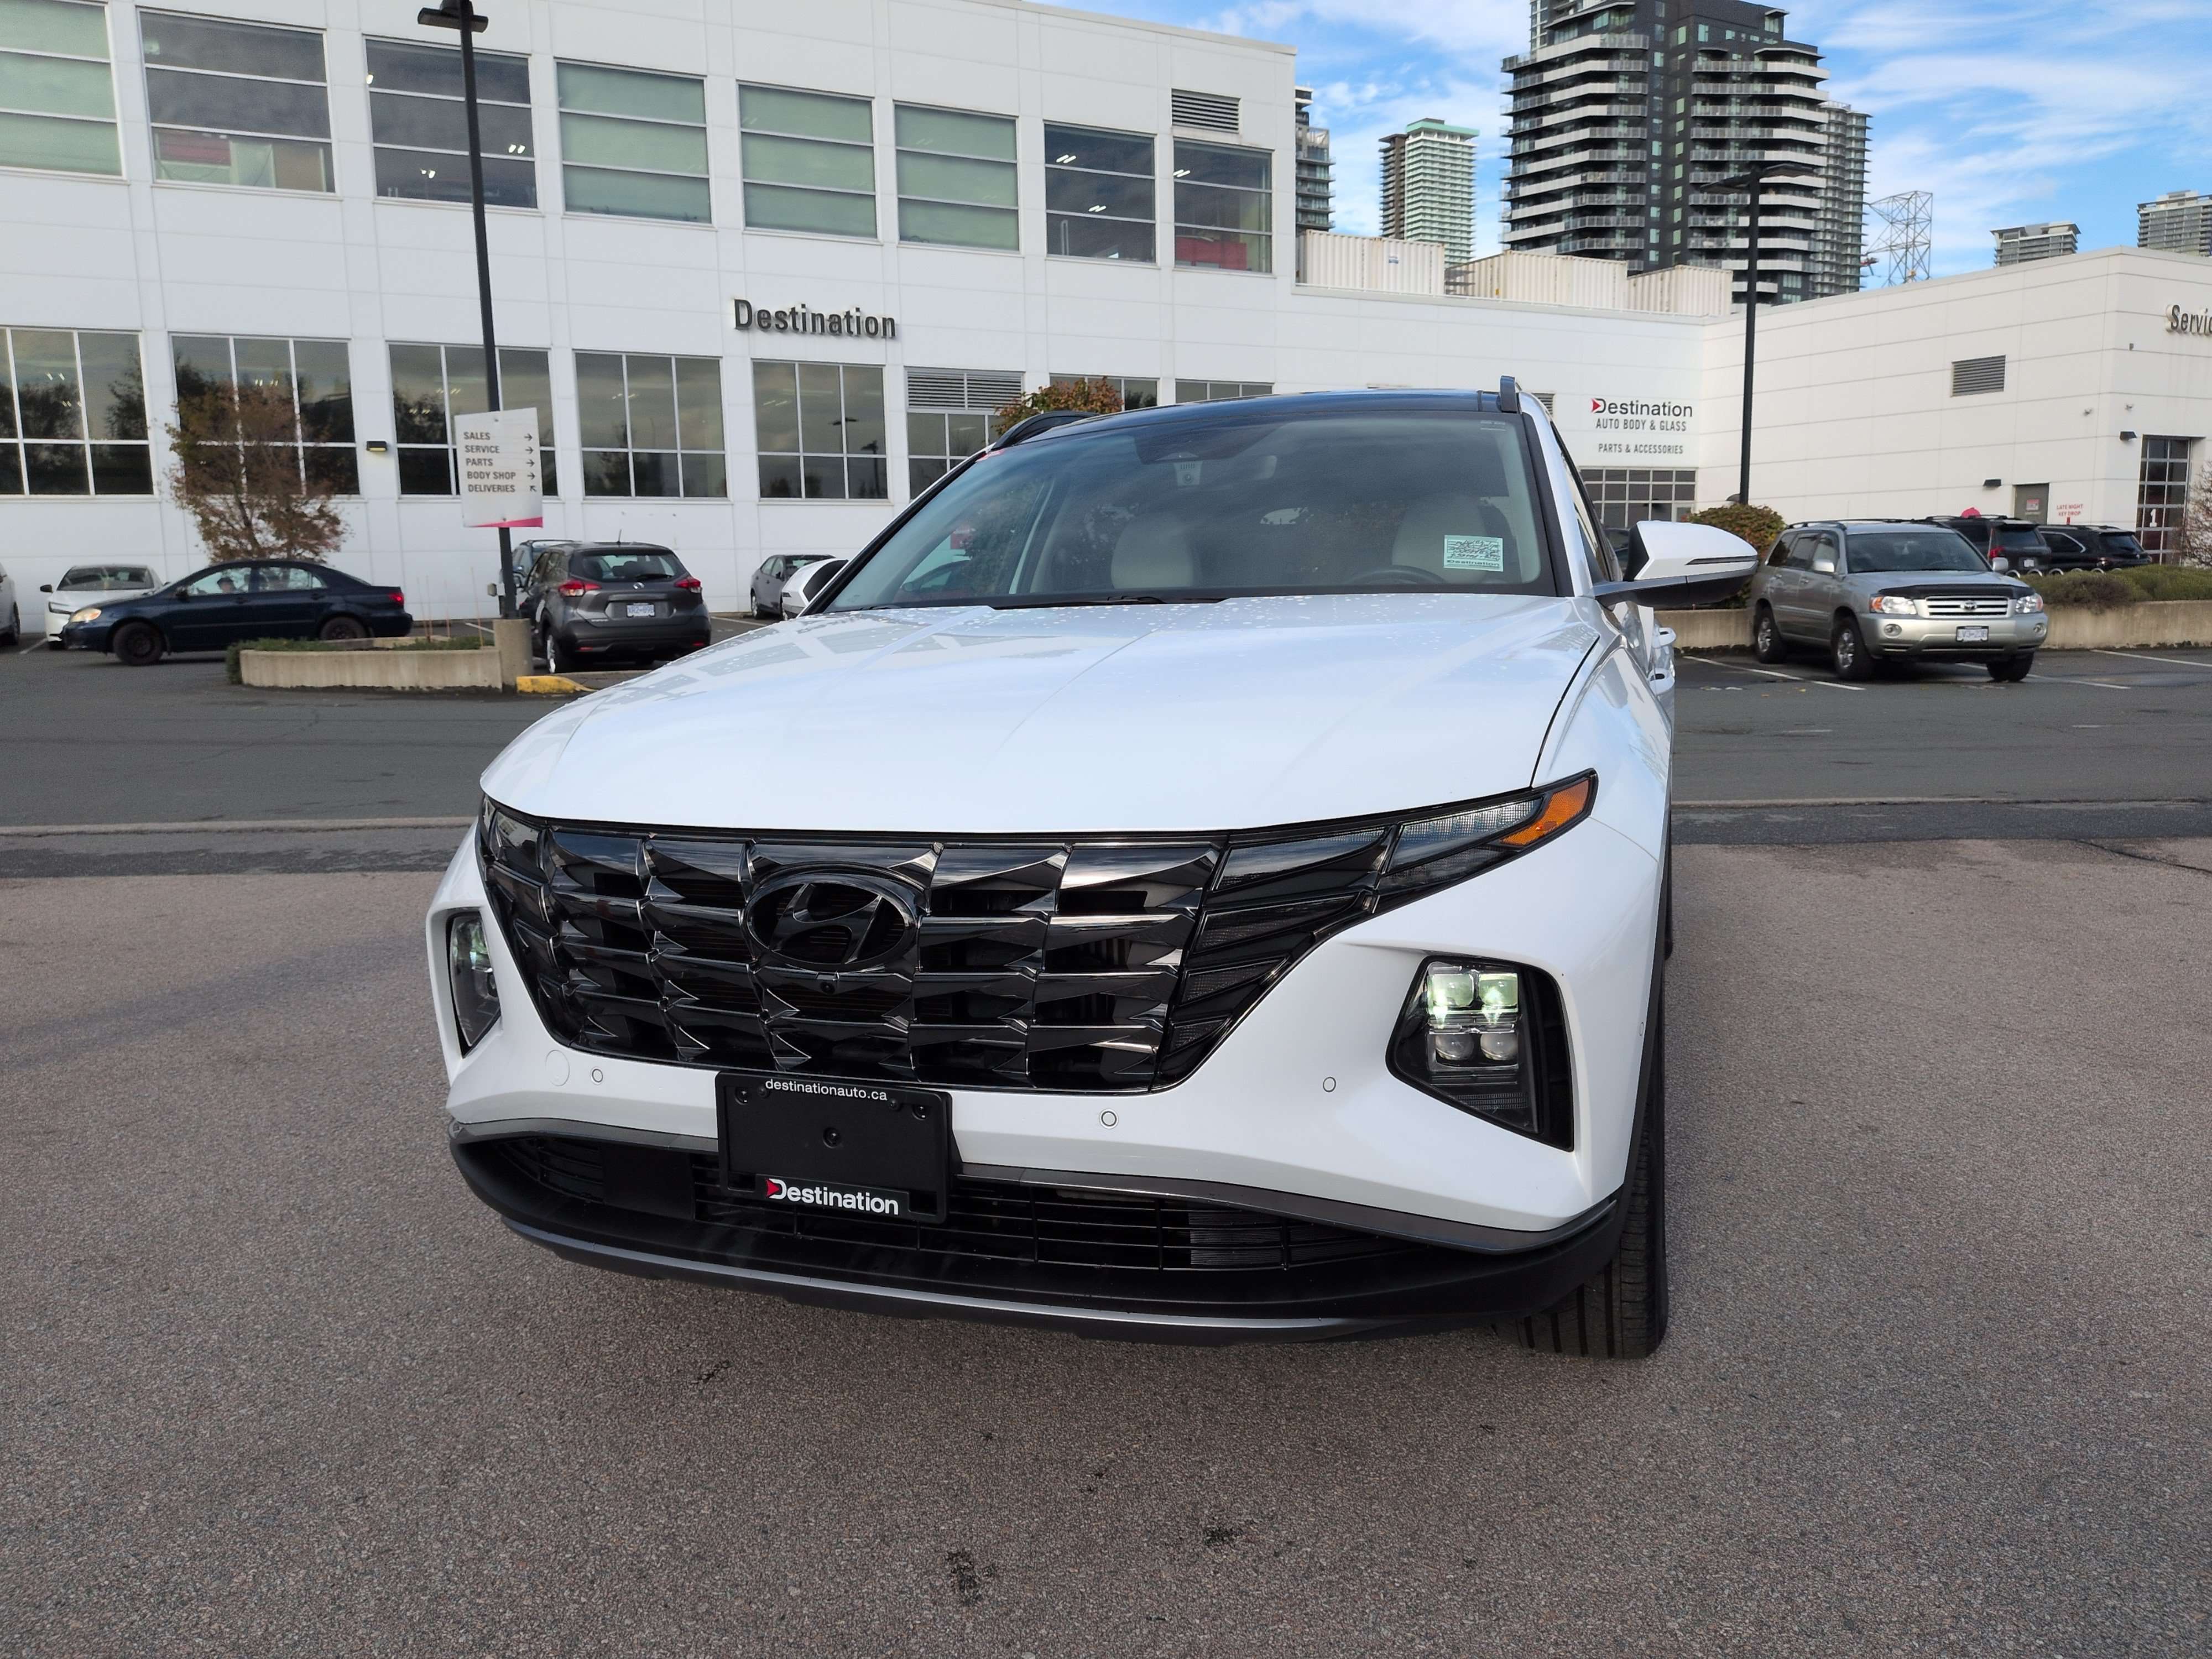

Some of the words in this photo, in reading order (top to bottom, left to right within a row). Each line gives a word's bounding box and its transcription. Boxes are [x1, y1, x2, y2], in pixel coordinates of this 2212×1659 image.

[734, 299, 895, 337] Destination
[1592, 398, 1693, 417] Destination
[1596, 418, 1619, 429] AUTO
[1624, 419, 1646, 430] BODY
[1650, 420, 1656, 430] &
[1660, 420, 1686, 431] GLASS
[464, 432, 491, 441] SALES
[465, 445, 499, 453] SERVICE
[1598, 444, 1622, 453] PARTS
[1625, 444, 1630, 453] &
[1634, 444, 1683, 454] ACCESSORIES
[2150, 509, 2157, 527] 1
[765, 1078, 888, 1101] destinationauto.ca
[766, 1178, 899, 1215] Destination
